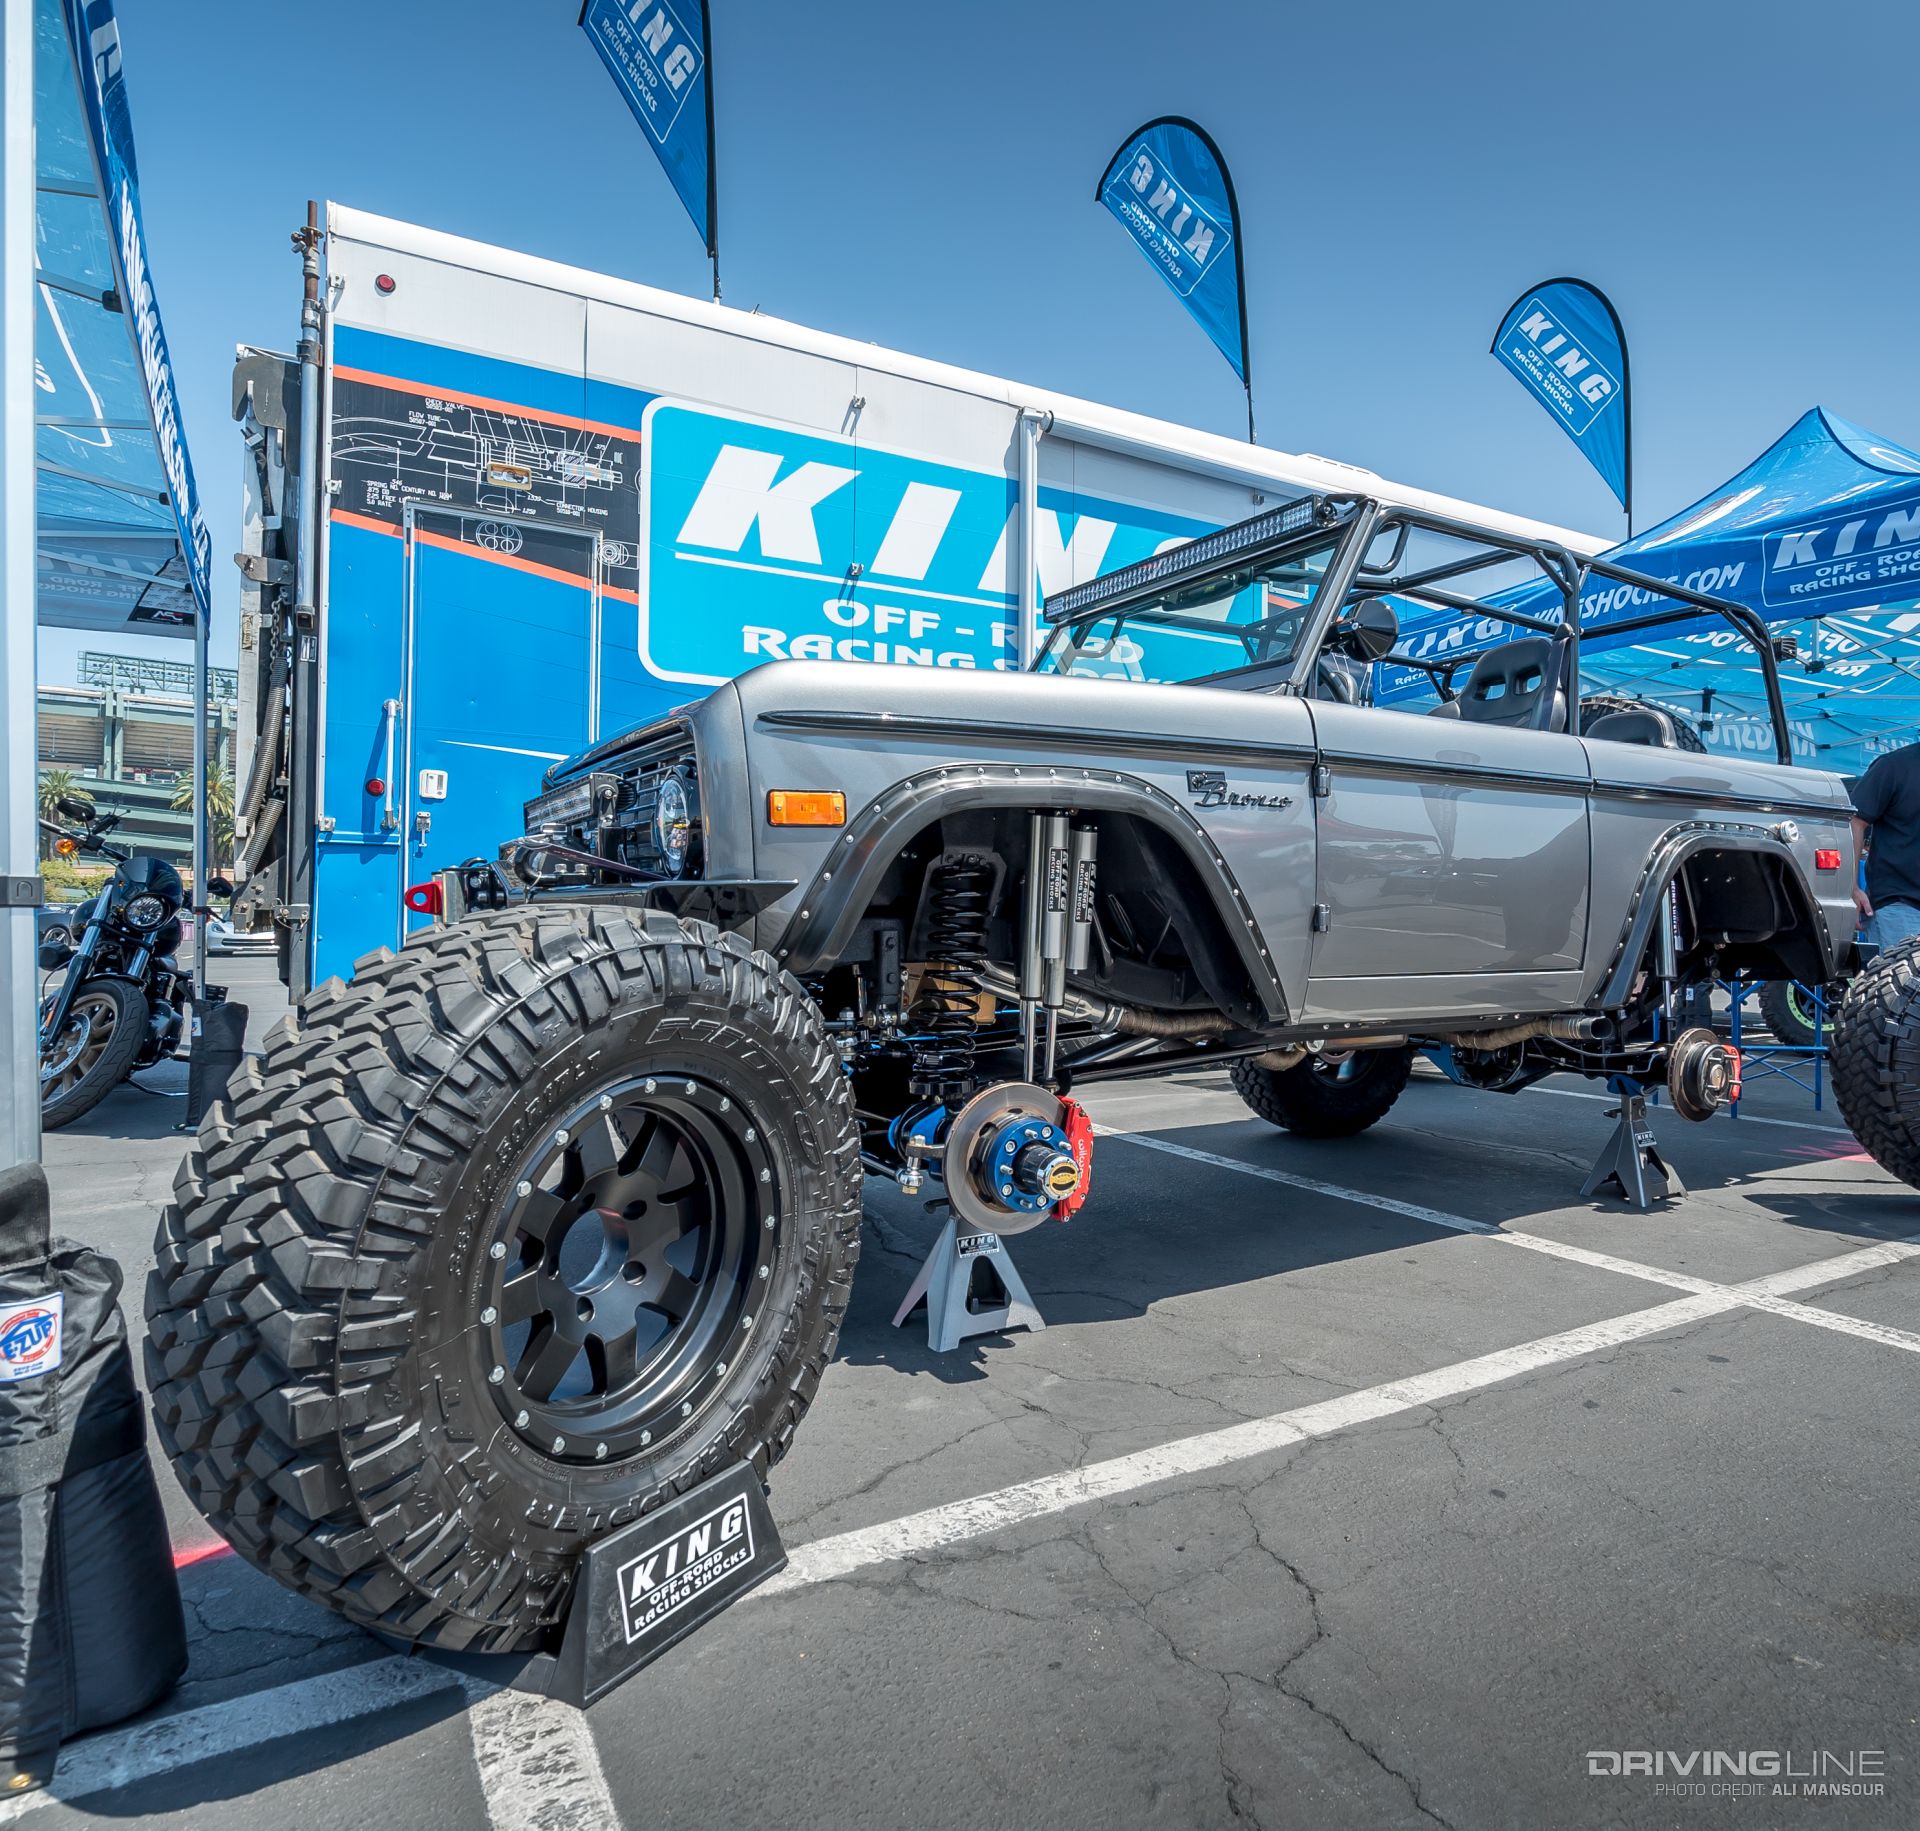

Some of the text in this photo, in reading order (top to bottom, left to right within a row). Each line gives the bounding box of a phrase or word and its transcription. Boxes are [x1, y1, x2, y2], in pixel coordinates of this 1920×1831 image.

[601, 17, 658, 112] RACING SHOCKS
[616, 19, 632, 45] OFF
[633, 52, 658, 88] ROAD
[618, 0, 696, 91] ING
[1512, 347, 1574, 415] RACING SHOCKS
[1519, 311, 1612, 404] KING
[1527, 349, 1545, 368] OFF
[1547, 372, 1573, 399] ROAD
[409, 411, 425, 419] FLOW
[367, 480, 388, 489] SPRING
[401, 485, 426, 495] CENTURY
[378, 500, 392, 508] RATE
[1790, 571, 1871, 594] RACING
[1815, 561, 1858, 577] OFF
[823, 599, 941, 639] OFF
[742, 625, 976, 669] RACING
[1194, 780, 1293, 808] Bronco
[960, 1235, 994, 1248] KING
[631, 1505, 743, 1600] KING
[635, 1547, 747, 1631] RACING SHOCKS
[650, 1550, 724, 1605] OFF-ROAD
